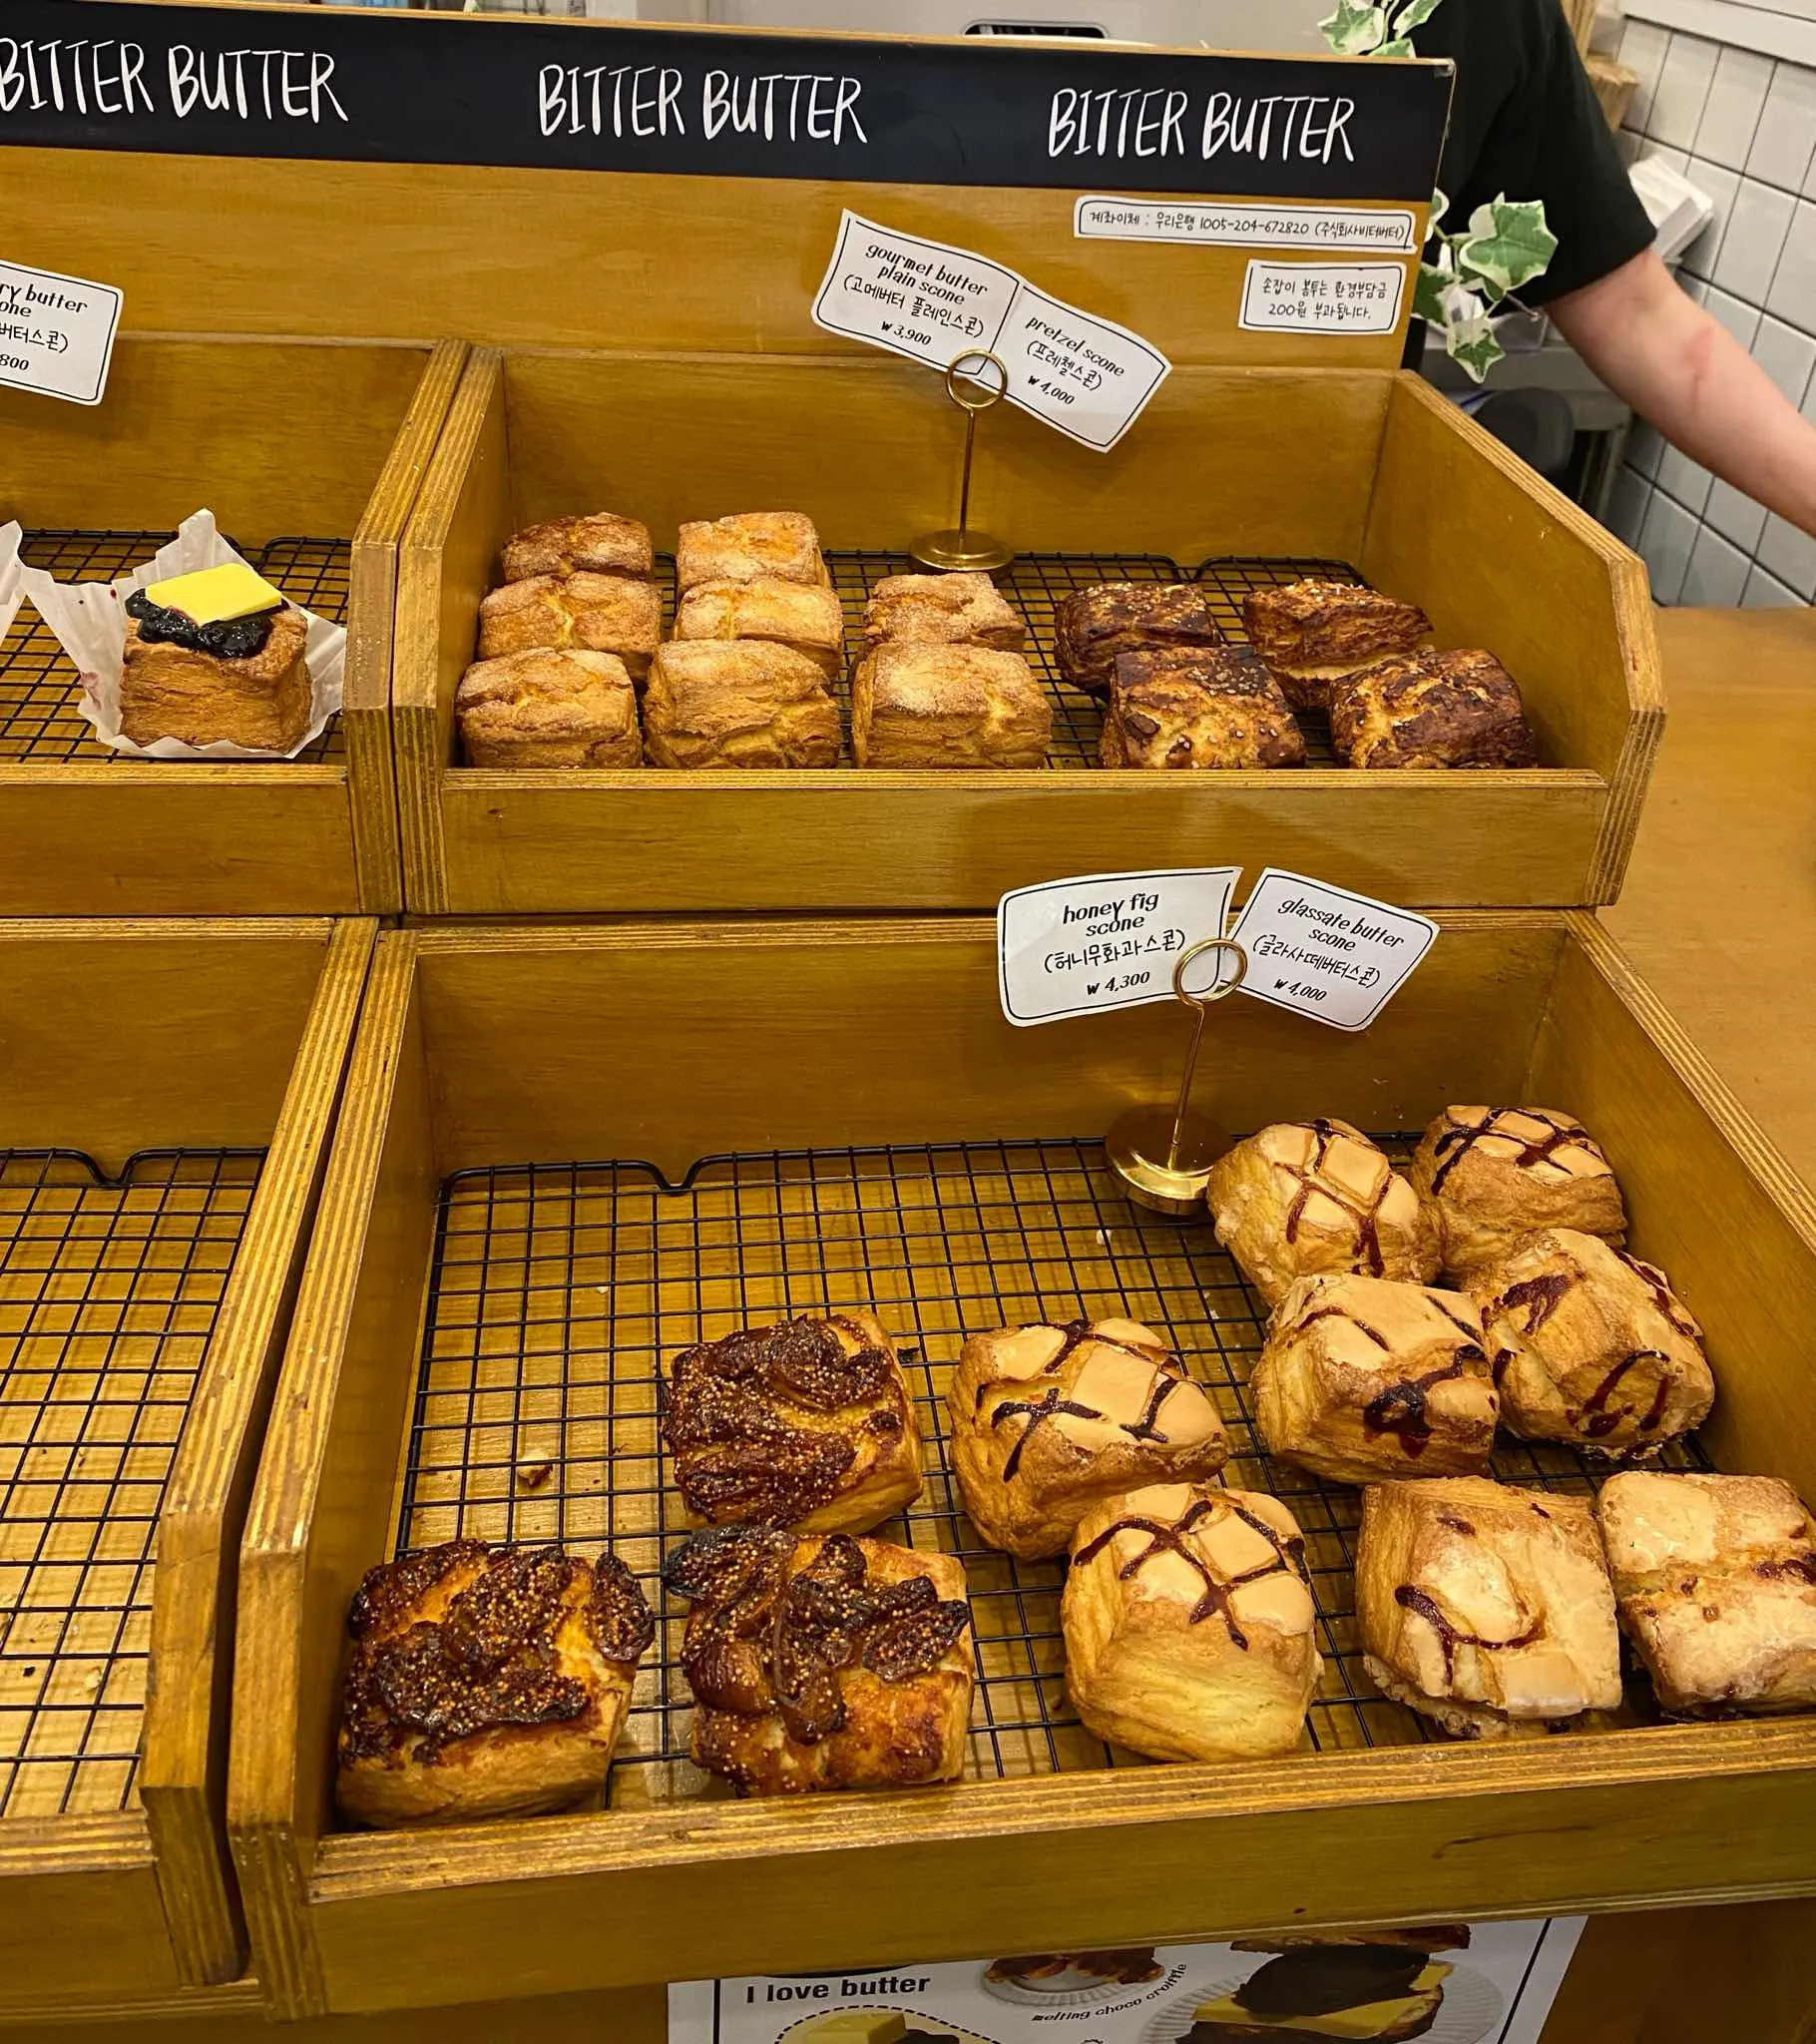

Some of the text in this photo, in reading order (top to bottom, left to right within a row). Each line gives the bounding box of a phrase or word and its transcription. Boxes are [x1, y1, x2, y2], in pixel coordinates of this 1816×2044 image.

[0, 37, 349, 124] BITTER BUTTER
[539, 64, 868, 146] BITTER BUTTER
[1049, 88, 1356, 165] BITTER BUTTER
[1154, 212, 1195, 232] 우리은행
[1199, 217, 1309, 235] 1005-204-672820
[864, 244, 989, 297] gourmet butter
[877, 266, 967, 305] plain scone
[25, 283, 88, 313] butter
[1261, 278, 1388, 299] 손잡이 봉투는 환경부담금
[0, 300, 32, 317] one
[843, 273, 985, 339] (고메버터 플레인스콘)
[1268, 300, 1372, 320] 200원 부과됩니다.
[0, 322, 69, 353] 버터스콘)
[894, 324, 932, 345] 3,900
[1026, 315, 1126, 378] pretzel scone
[0, 353, 30, 371] 800
[1026, 340, 1103, 392] (프레첼스콘)
[1039, 380, 1076, 406] 4,000
[1063, 891, 1159, 925] honey fig
[1085, 914, 1145, 937] scone
[1276, 898, 1405, 949] glassate butter
[1044, 928, 1186, 974] (허니무화과스콘)
[1307, 928, 1357, 953] scone
[1251, 933, 1382, 988] (글라사떼버터스콘)
[1104, 970, 1150, 994] 4,300
[1287, 982, 1327, 1002] 4,000
[746, 1976, 931, 2004] I love butter
[1031, 2011, 1092, 2022] melting
[1095, 1997, 1142, 2015] choco
